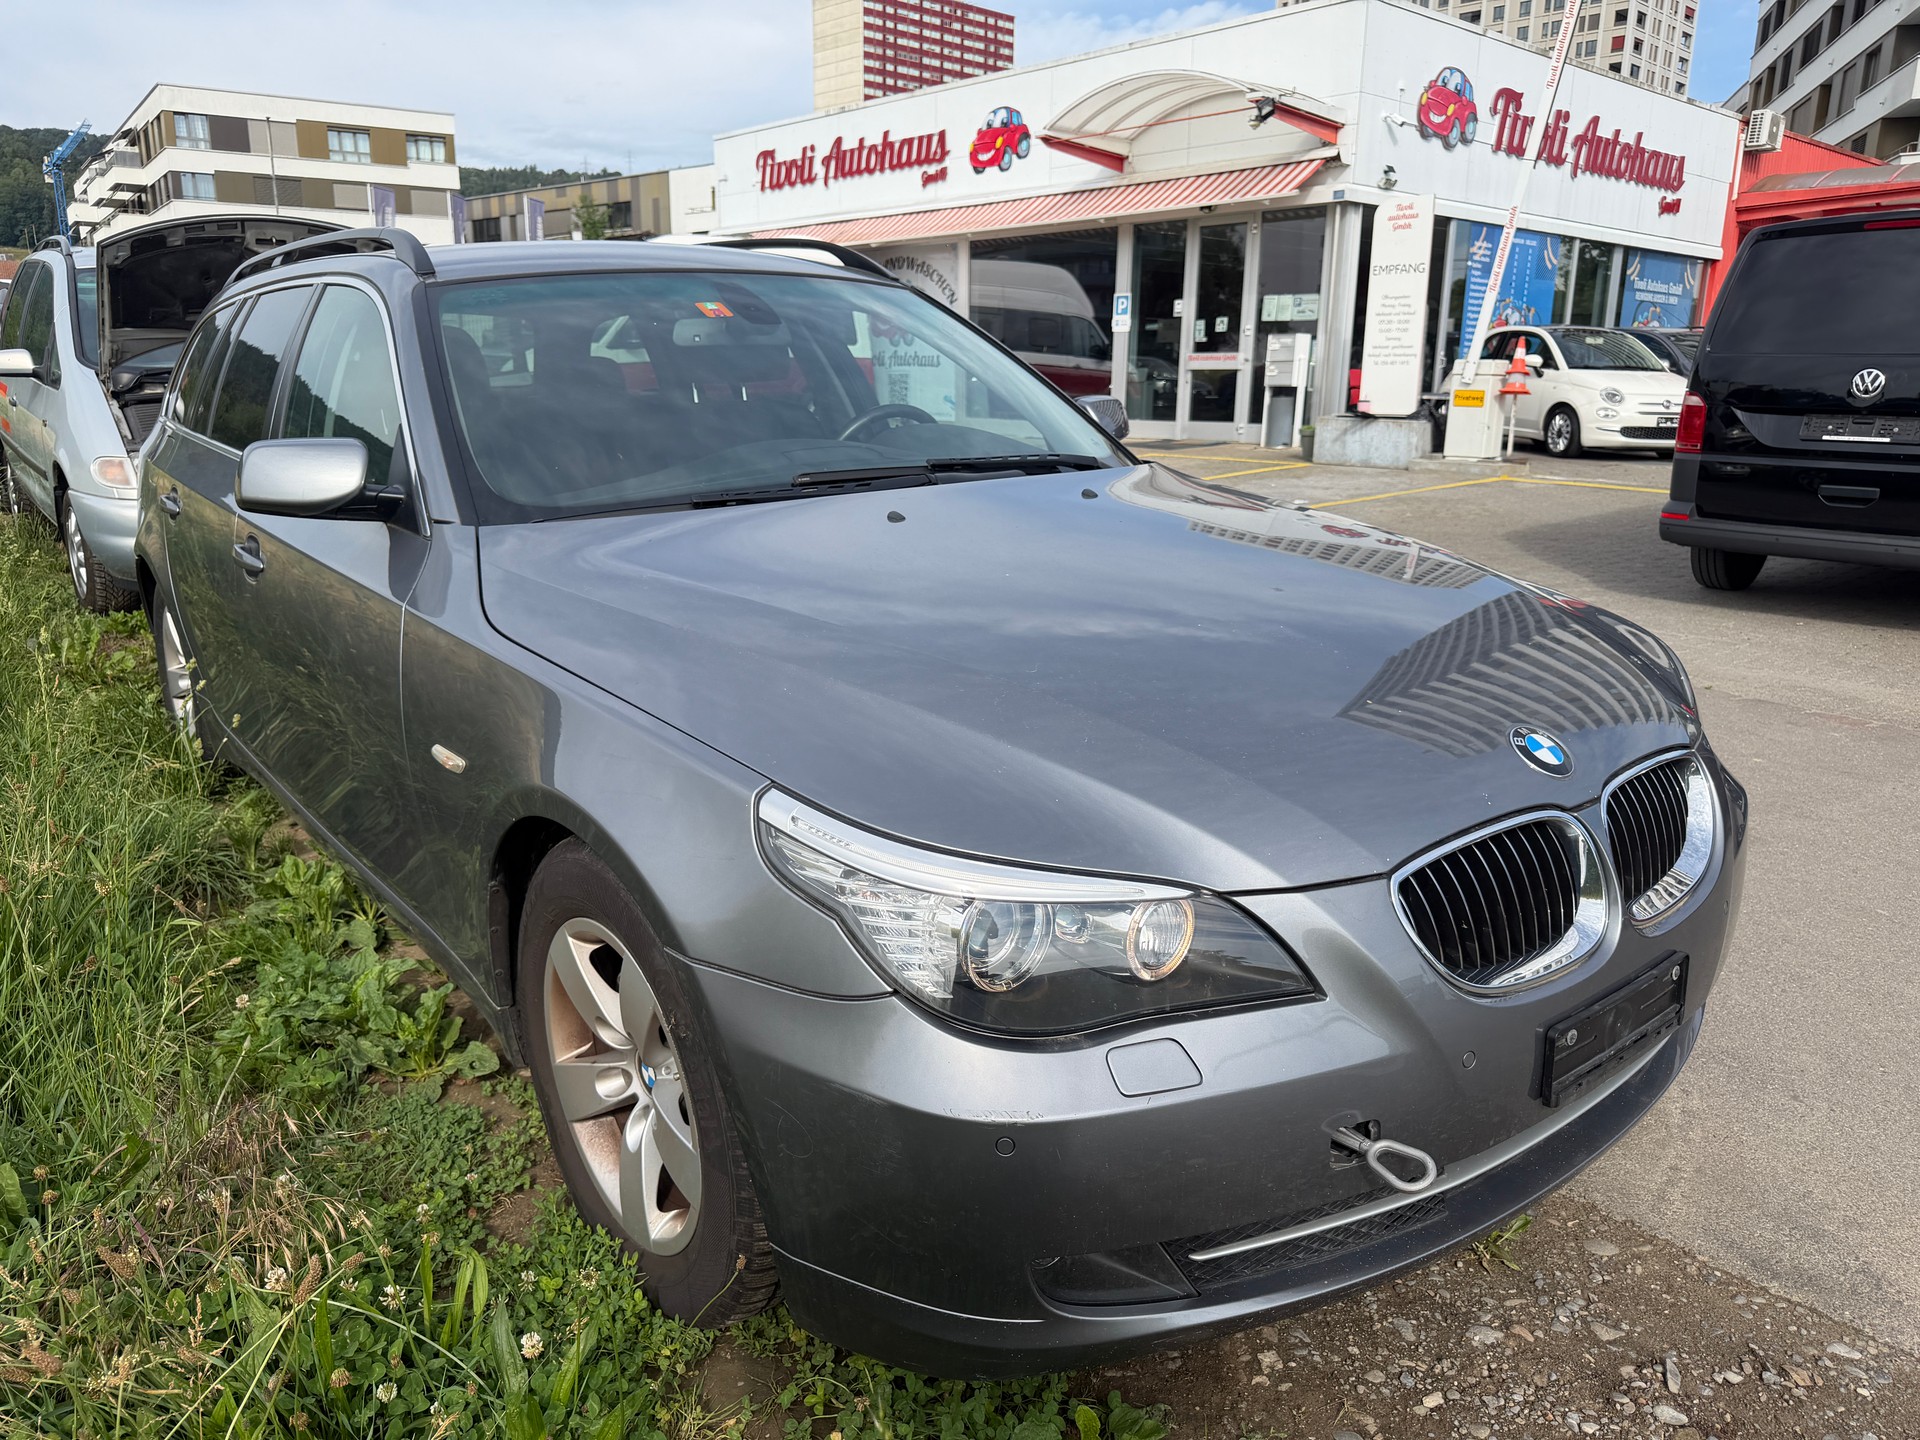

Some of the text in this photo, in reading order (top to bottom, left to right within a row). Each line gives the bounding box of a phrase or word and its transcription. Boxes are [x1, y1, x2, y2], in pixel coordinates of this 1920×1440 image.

[755, 129, 951, 193] Tivoli Autohaus
[1570, 115, 1686, 193] Autohaus
[1372, 262, 1426, 277] EMPFANG
[1117, 298, 1128, 314] P
